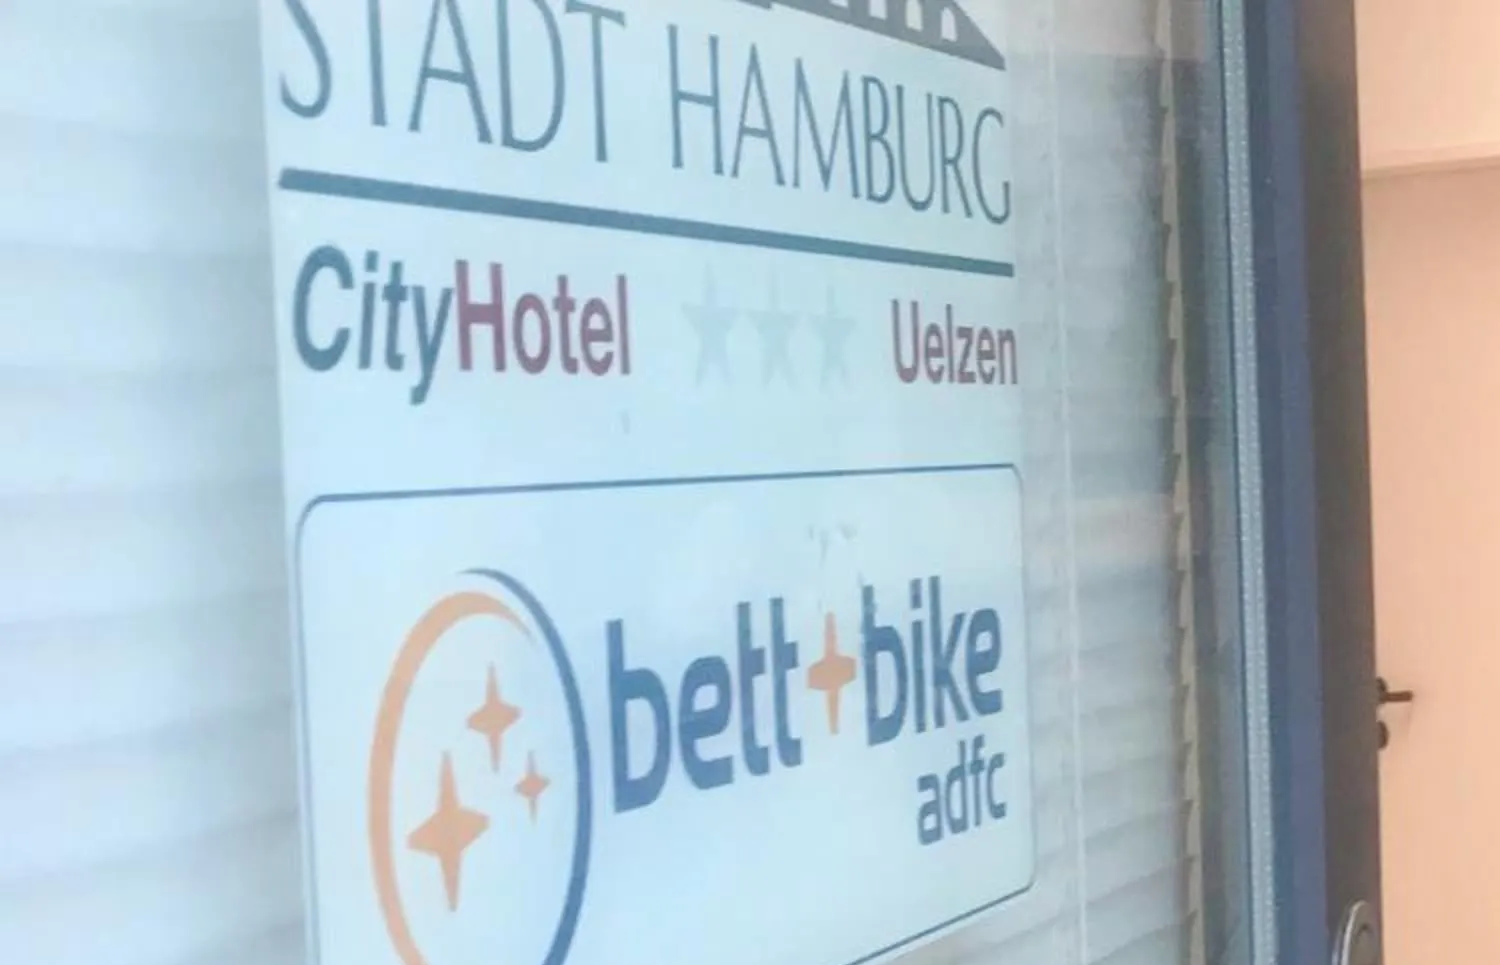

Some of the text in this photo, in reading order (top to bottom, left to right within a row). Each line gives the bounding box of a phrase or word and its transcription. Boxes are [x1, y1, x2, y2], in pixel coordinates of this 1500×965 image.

[667, 24, 1012, 225] HAMBURG
[292, 244, 1018, 406] CityHotel Uelzen
[917, 734, 1007, 845] adfc
